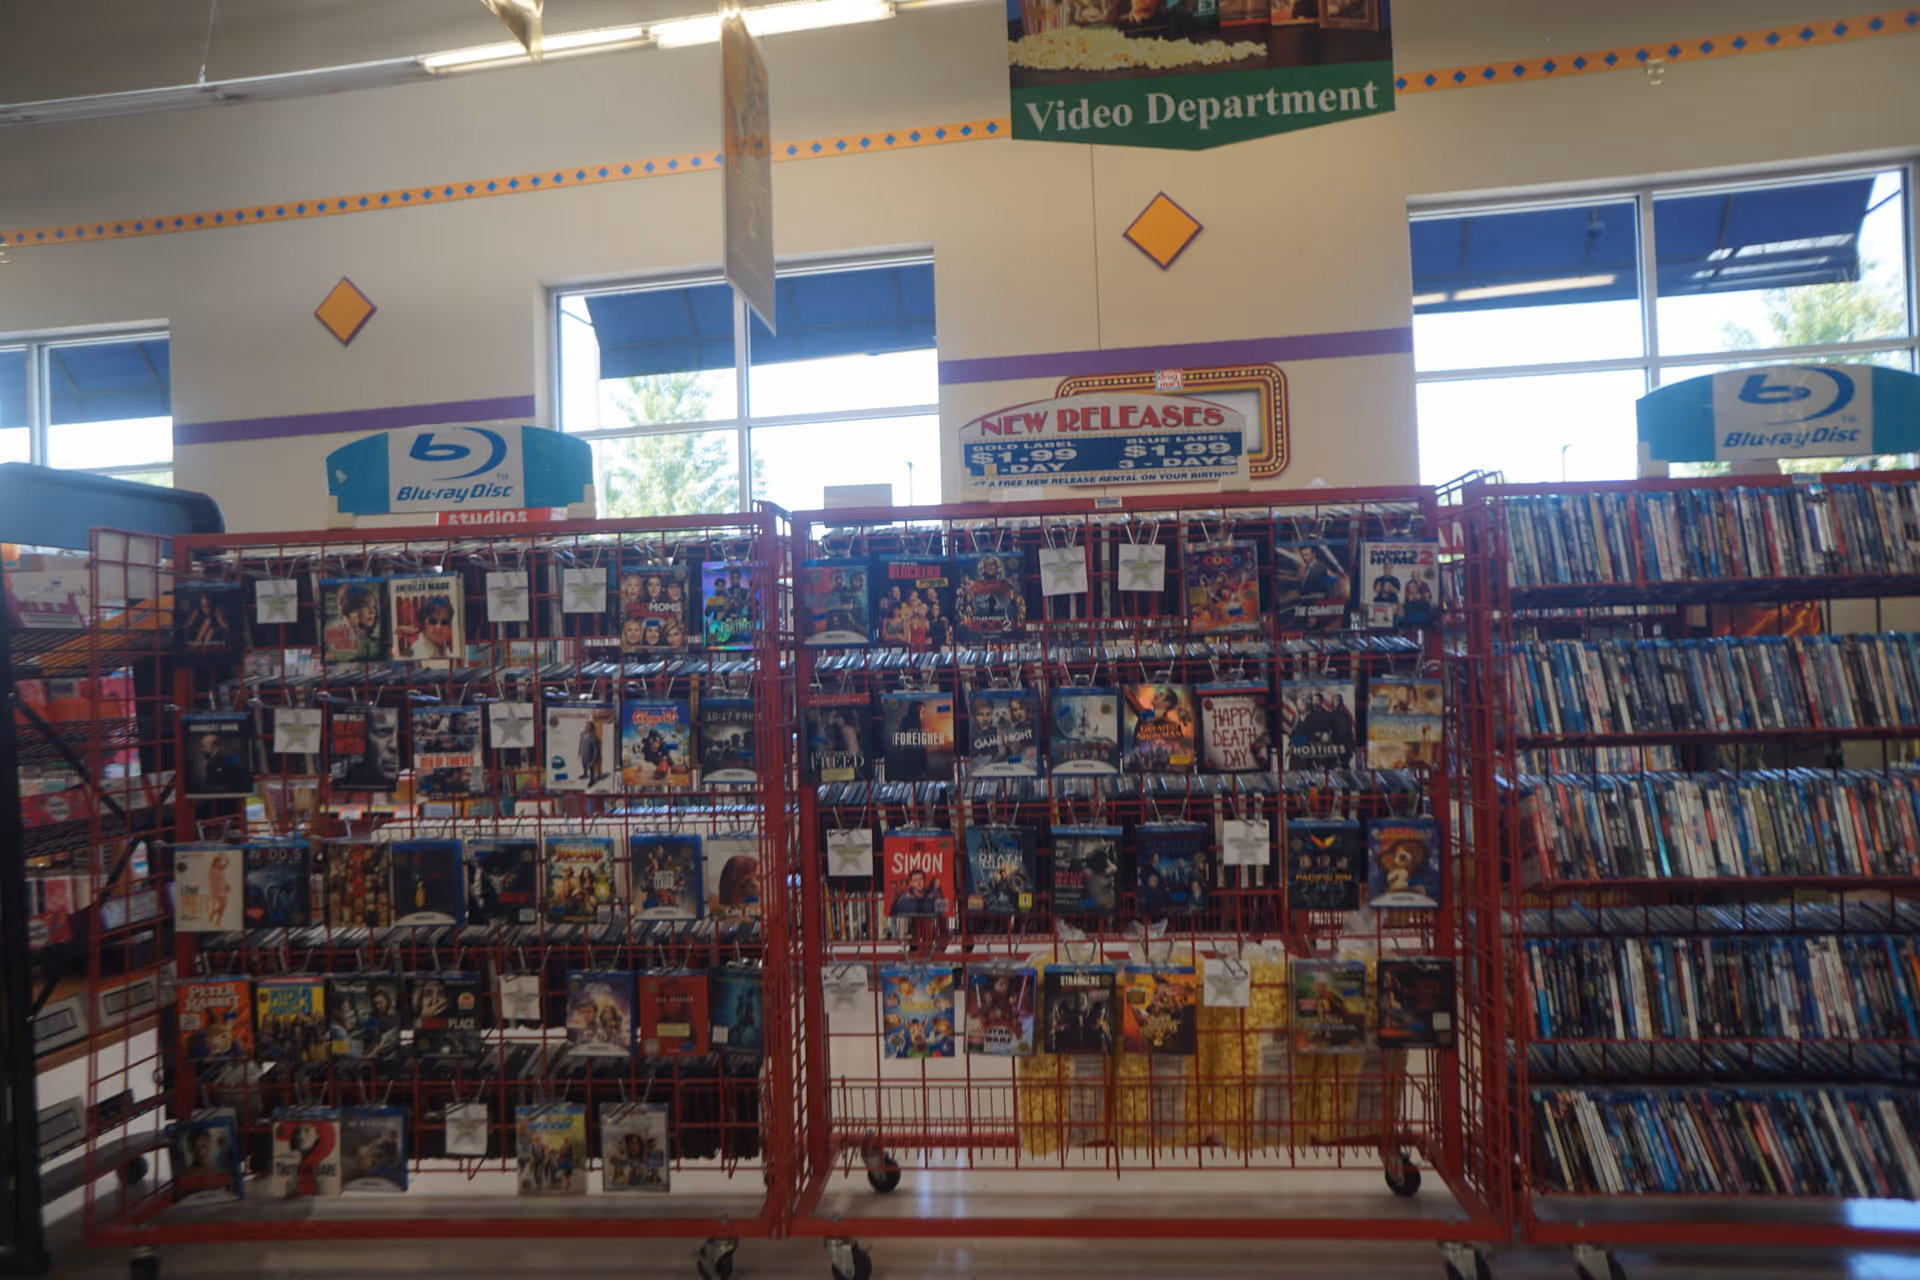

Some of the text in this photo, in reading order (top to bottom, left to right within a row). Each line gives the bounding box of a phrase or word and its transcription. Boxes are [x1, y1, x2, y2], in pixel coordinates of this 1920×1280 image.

[1026, 80, 1378, 132] Video Department
[981, 404, 1224, 437] NEW RELEASES
[972, 440, 1077, 452] GOLD LABEL
[1126, 434, 1228, 444] BLUE LABEL
[971, 448, 1078, 464] $1.99
[1124, 442, 1231, 458] $1.99
[1119, 459, 1135, 469] 3
[1163, 455, 1238, 467] DAYS
[1051, 476, 1096, 485] RELEASE
[1099, 474, 1137, 482] RENTAL
[1160, 472, 1188, 480] YOUR
[448, 510, 528, 525] studios
[1202, 553, 1241, 567] COCO
[1418, 550, 1435, 566] 2
[428, 581, 450, 590] MADE
[648, 601, 681, 612] MOMS
[1003, 619, 1012, 632] 2
[1212, 706, 1256, 728] HAPPY
[895, 731, 945, 746] FOREIGNER
[1213, 728, 1257, 748] DEATH
[1223, 748, 1248, 768] DAY
[891, 851, 944, 874] SIMON
